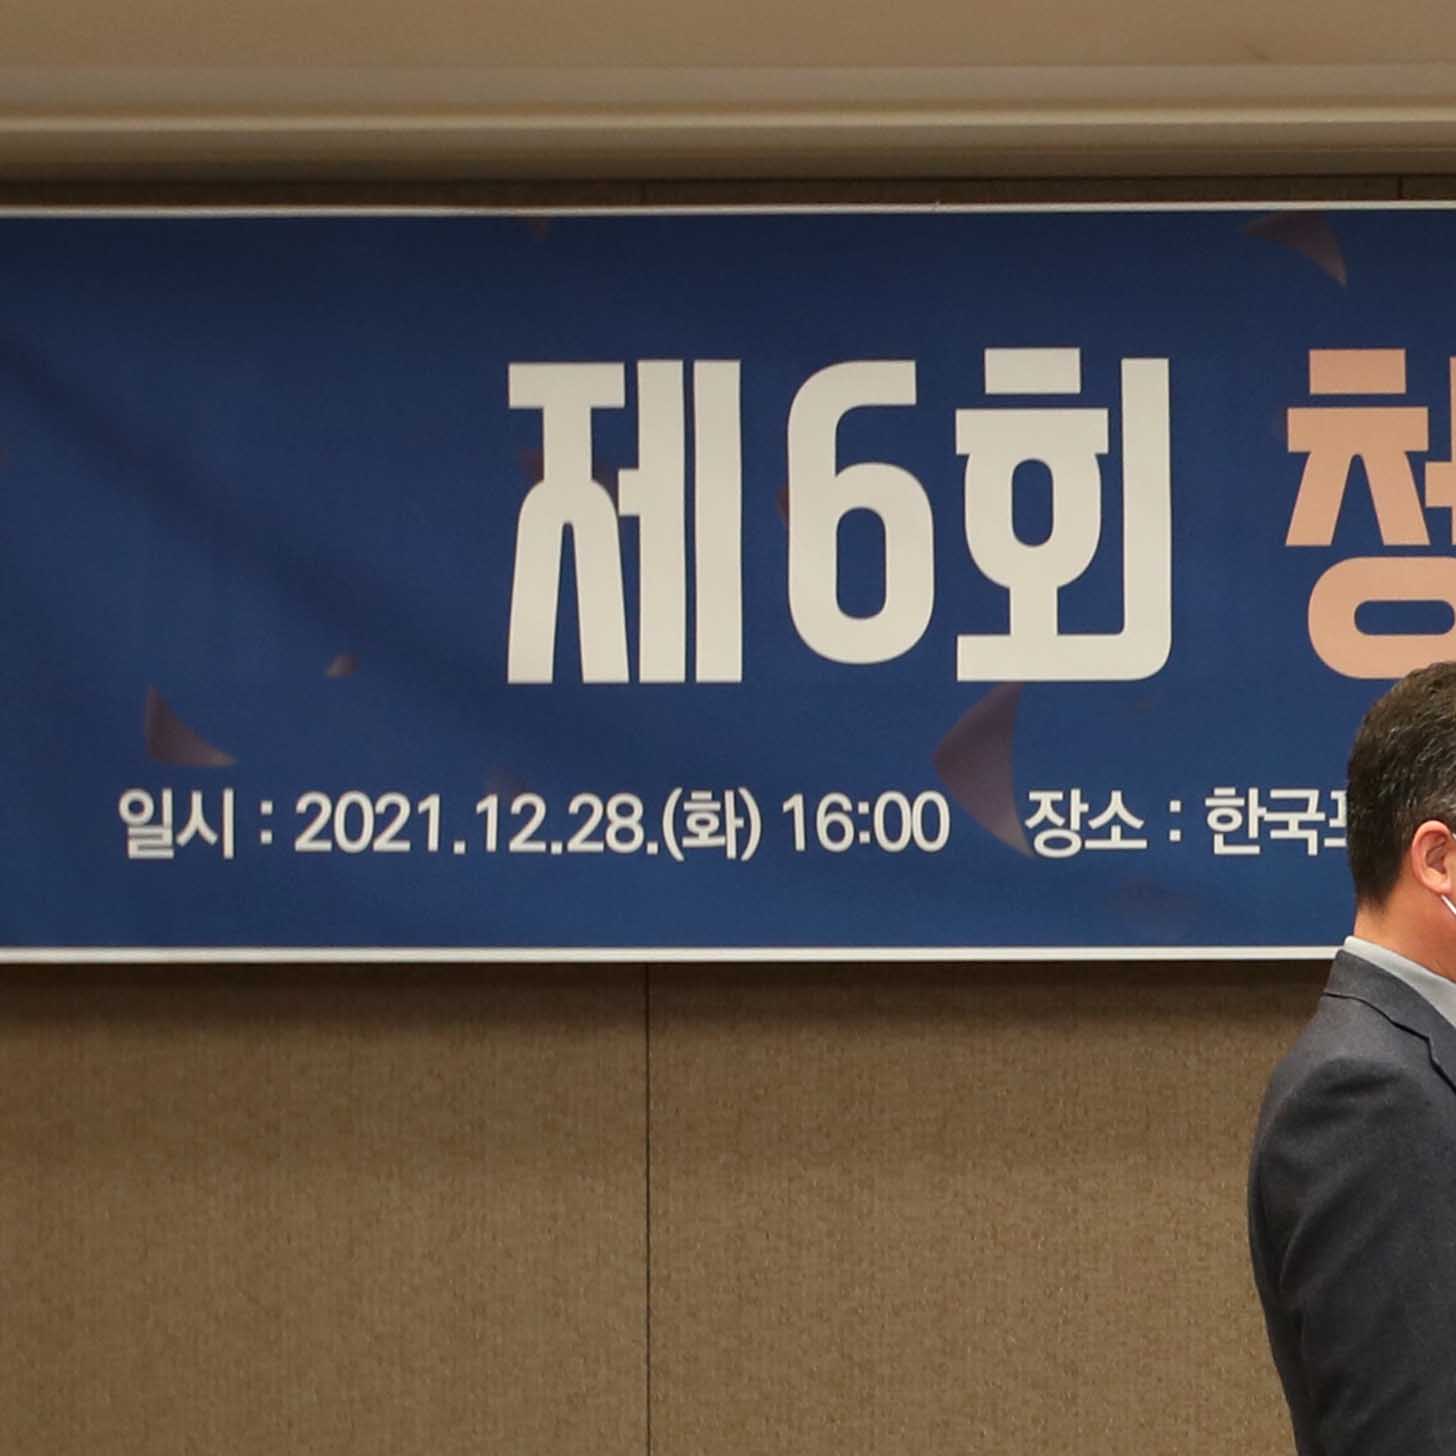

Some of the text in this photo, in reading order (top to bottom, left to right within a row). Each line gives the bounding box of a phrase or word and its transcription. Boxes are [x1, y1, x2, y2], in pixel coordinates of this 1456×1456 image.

[507, 348, 1172, 683] 제6회
[119, 788, 235, 859] 일시
[295, 788, 761, 861] 2021.12.28.(화)
[782, 791, 950, 852] 16:00
[1025, 788, 1148, 858] 장소
